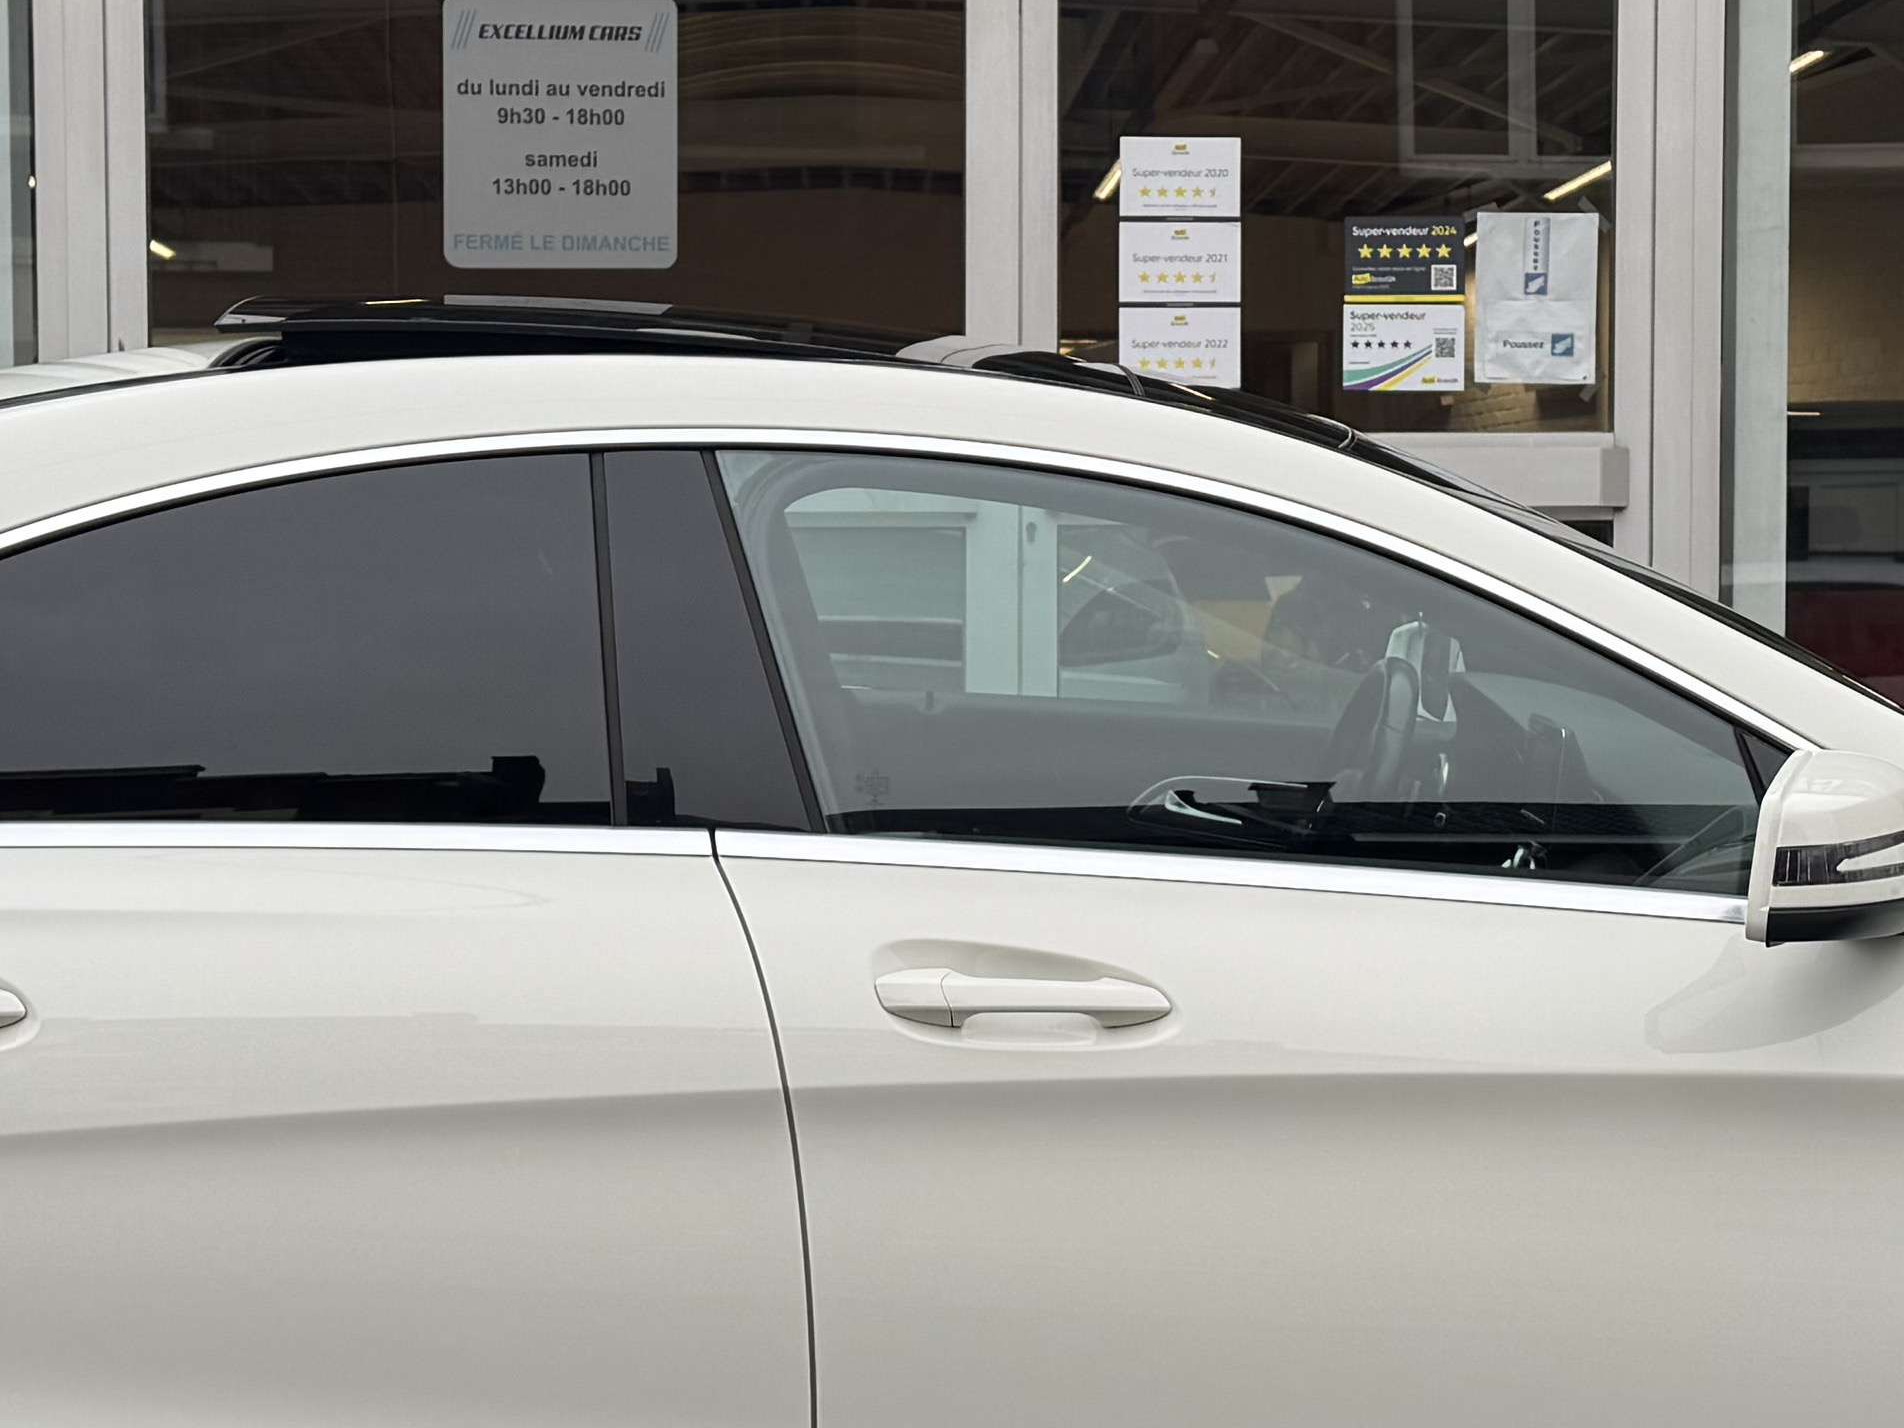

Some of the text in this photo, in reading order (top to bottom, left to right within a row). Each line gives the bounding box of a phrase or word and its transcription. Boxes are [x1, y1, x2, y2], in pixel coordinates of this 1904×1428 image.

[478, 23, 643, 42] EXCELLIUM CARS
[456, 78, 666, 98] du lundi au vendredi
[497, 107, 546, 125] 9h30
[565, 108, 625, 126] 18h00
[524, 150, 598, 168] samedi
[1205, 168, 1229, 178] 2020
[492, 178, 551, 196] 13h00
[572, 179, 631, 197] 18h00
[1352, 225, 1457, 238] Super-vendeur 2024
[530, 234, 556, 252] LE
[561, 234, 670, 253] DIMANCHE
[1205, 254, 1228, 263] 2021
[1349, 310, 1426, 322] Super-vendeur
